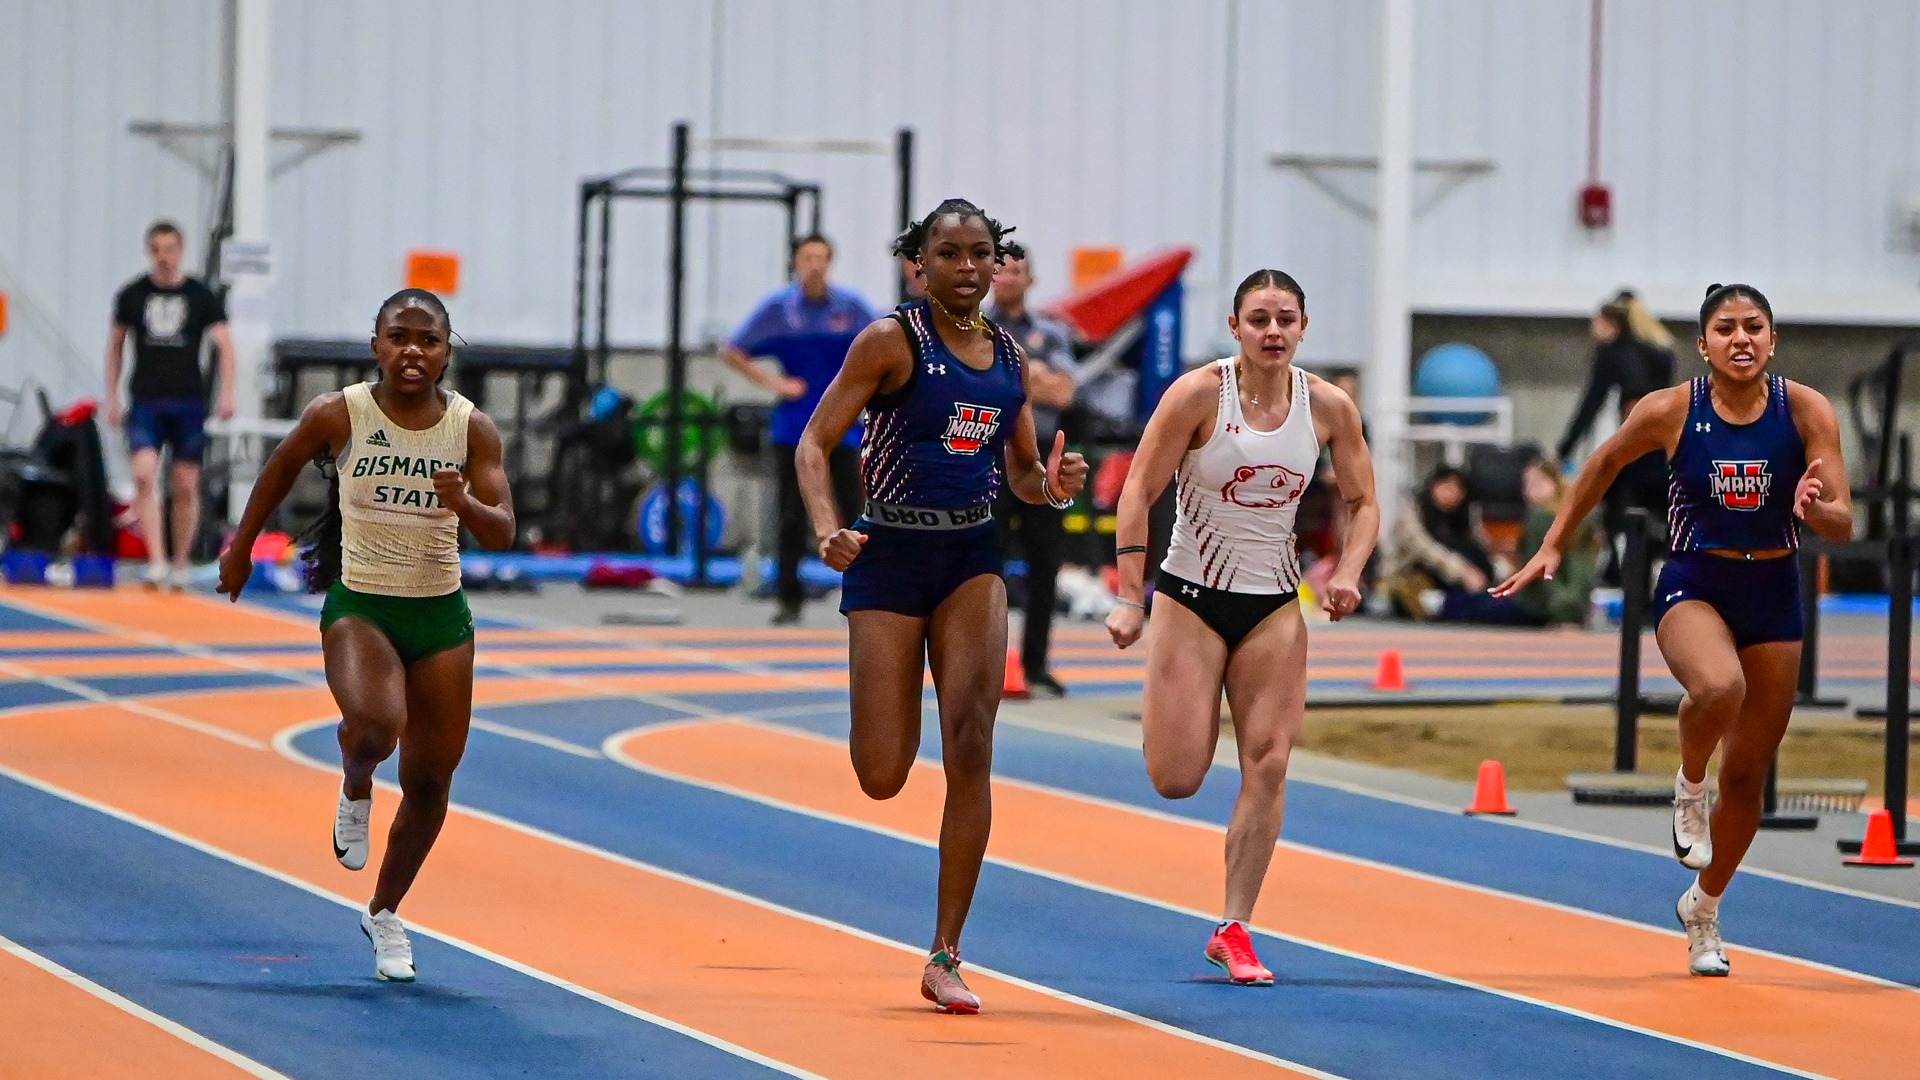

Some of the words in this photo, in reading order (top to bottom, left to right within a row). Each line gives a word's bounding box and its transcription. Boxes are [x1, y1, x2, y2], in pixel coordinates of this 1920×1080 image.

[947, 419, 995, 440] MARY
[365, 439, 390, 448] adidas
[352, 456, 464, 479] BISMAR
[1714, 476, 1767, 493] MARY
